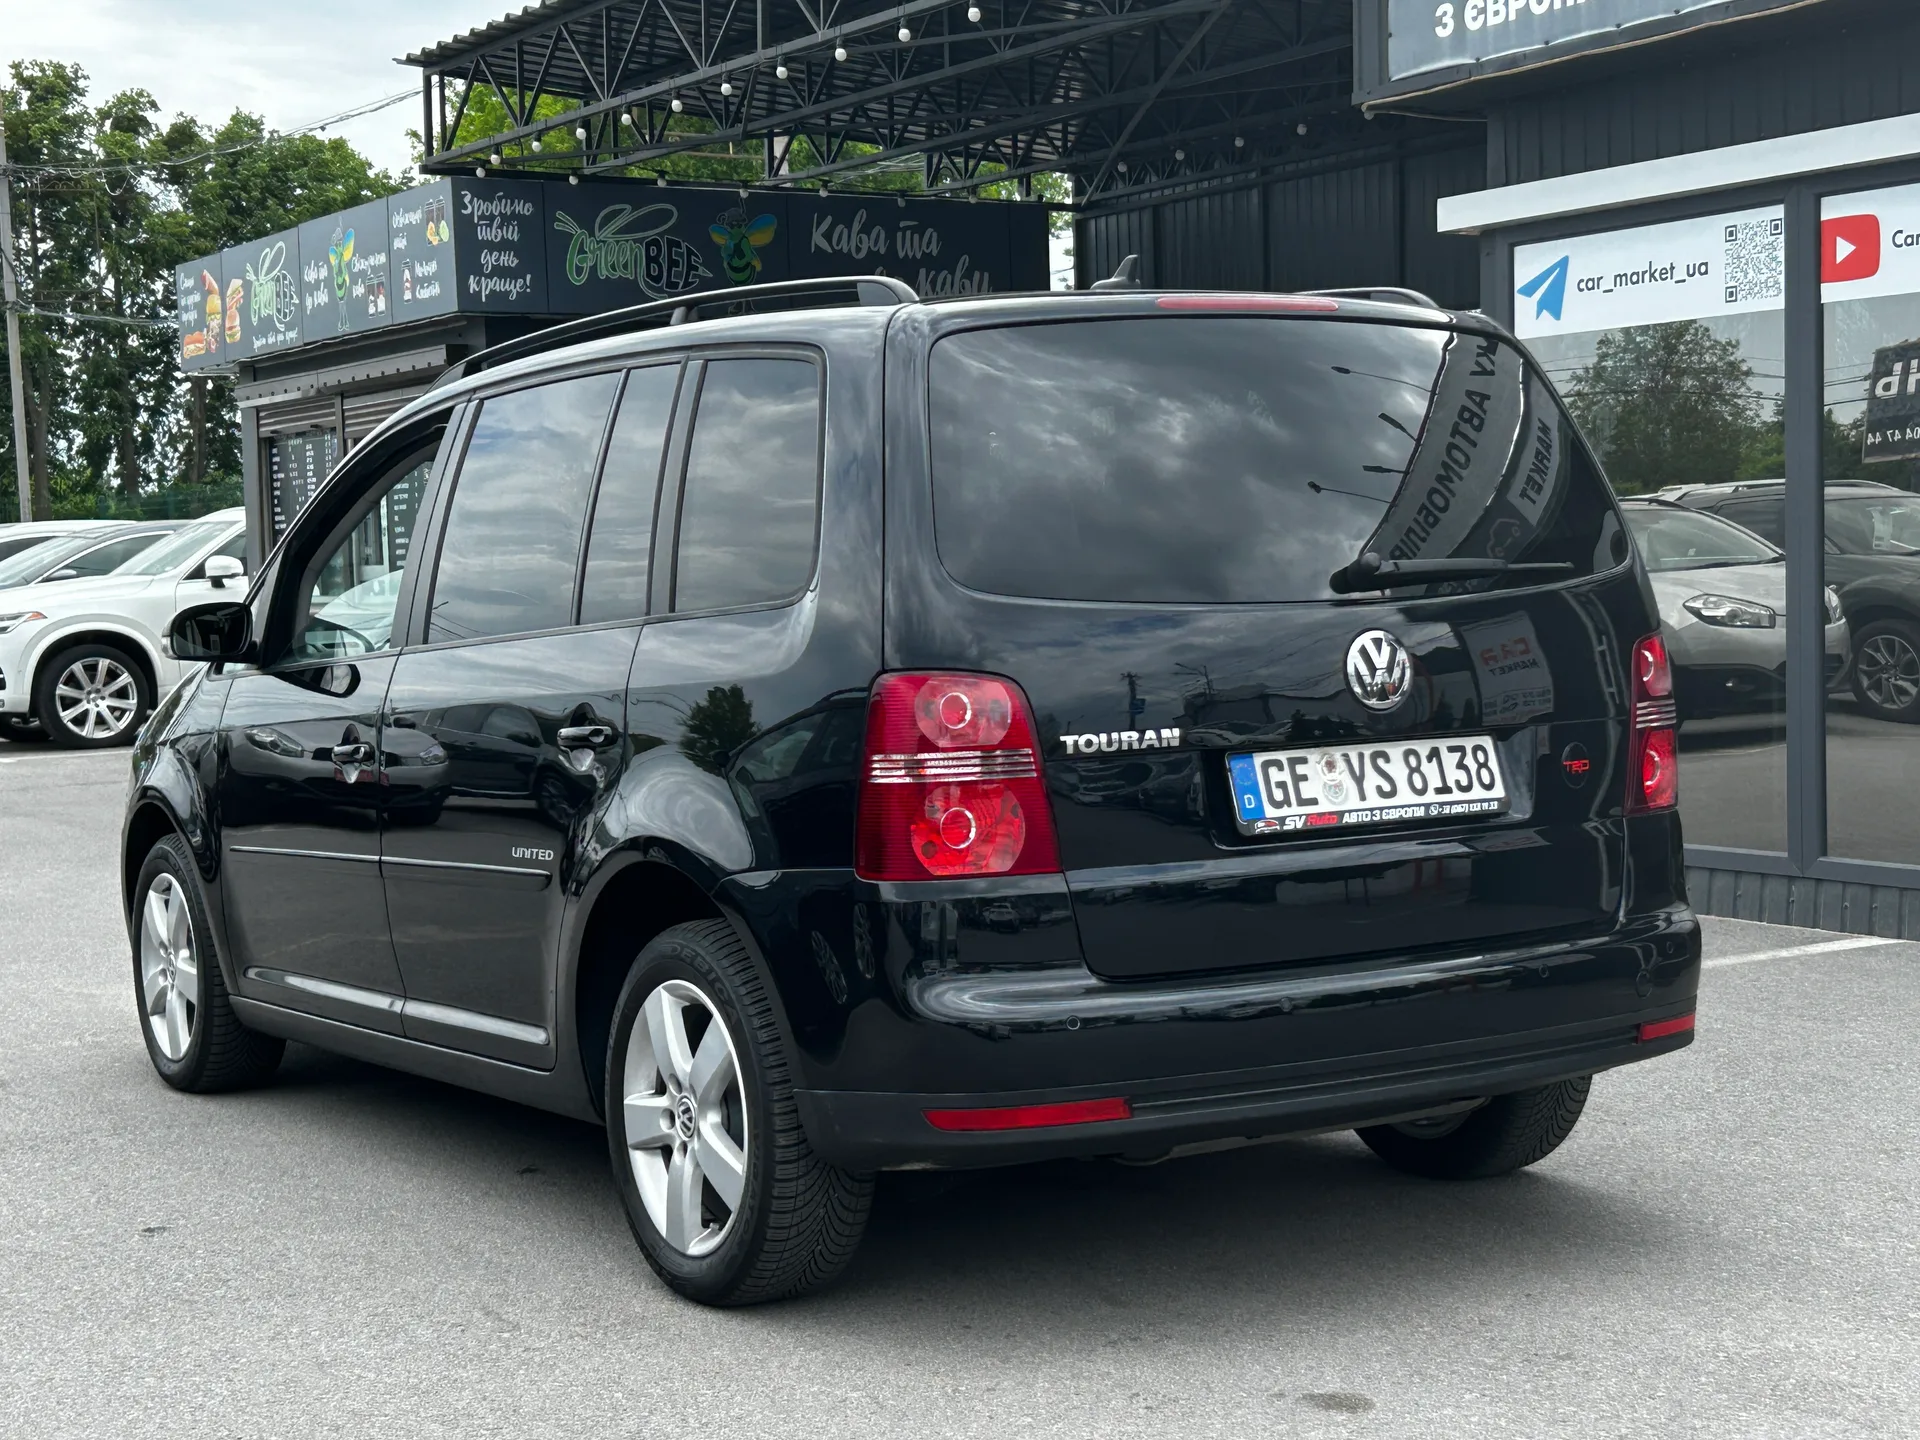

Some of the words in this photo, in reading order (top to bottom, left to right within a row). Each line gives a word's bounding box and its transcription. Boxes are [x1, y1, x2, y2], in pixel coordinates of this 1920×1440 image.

[1464, 0, 1586, 31] ЄВР
[461, 190, 534, 223] Зробимо
[477, 216, 520, 242] твій
[811, 208, 889, 259] Кава
[896, 220, 942, 259] та
[480, 250, 519, 273] день
[468, 273, 532, 302] краще!
[1576, 260, 1709, 294] car_market_ua
[1059, 728, 1180, 754] TOURAN
[1260, 756, 1319, 810] GE
[1341, 749, 1398, 803] YS
[1402, 743, 1496, 797] 8138
[1244, 794, 1256, 809] D
[1283, 816, 1305, 830] SV
[511, 846, 554, 861] UNITED
